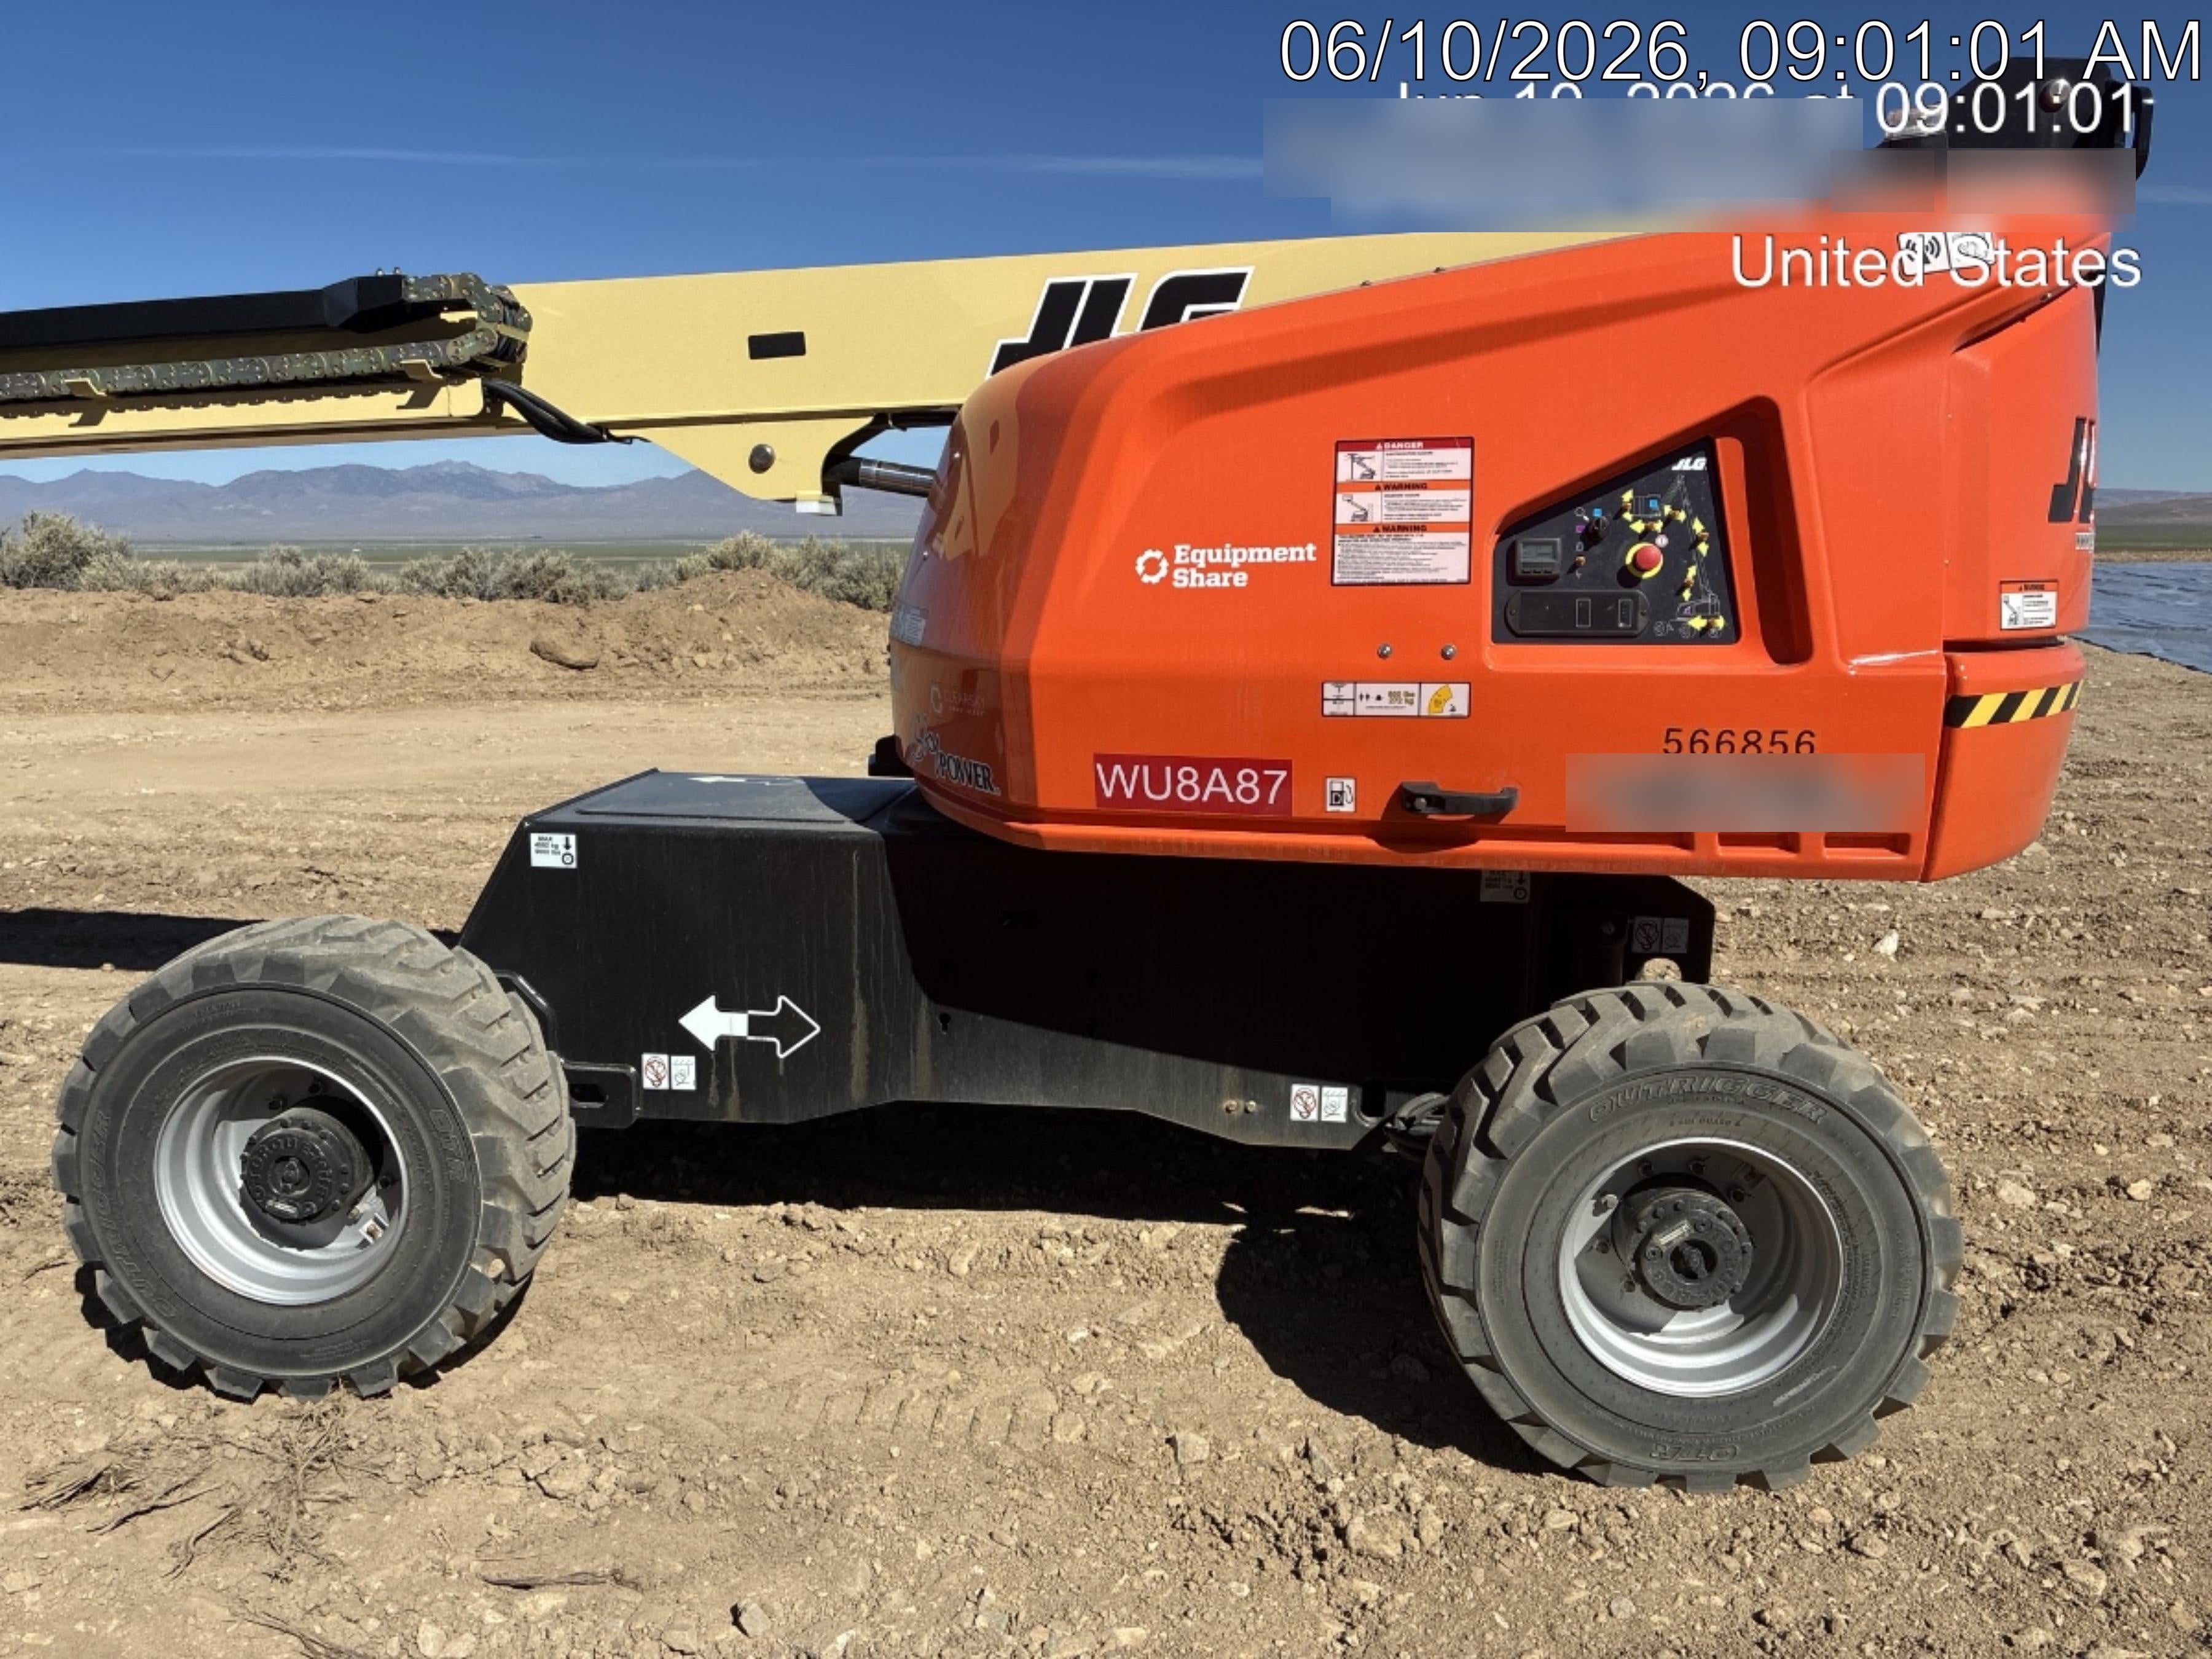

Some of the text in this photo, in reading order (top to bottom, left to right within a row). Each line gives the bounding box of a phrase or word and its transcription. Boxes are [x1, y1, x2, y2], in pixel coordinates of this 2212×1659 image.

[1671, 457, 1707, 471] JLG
[2048, 417, 2096, 523] JL
[1384, 482, 1427, 491] WARNING
[1382, 524, 1427, 533] WARNING
[1174, 543, 1317, 568] Equipment
[1172, 567, 1248, 587] Share
[1663, 728, 1816, 753] 566856
[934, 750, 997, 793] POWER
[1096, 763, 1288, 805] WU8A87
[1588, 1077, 1828, 1125] OUTRIGGER
